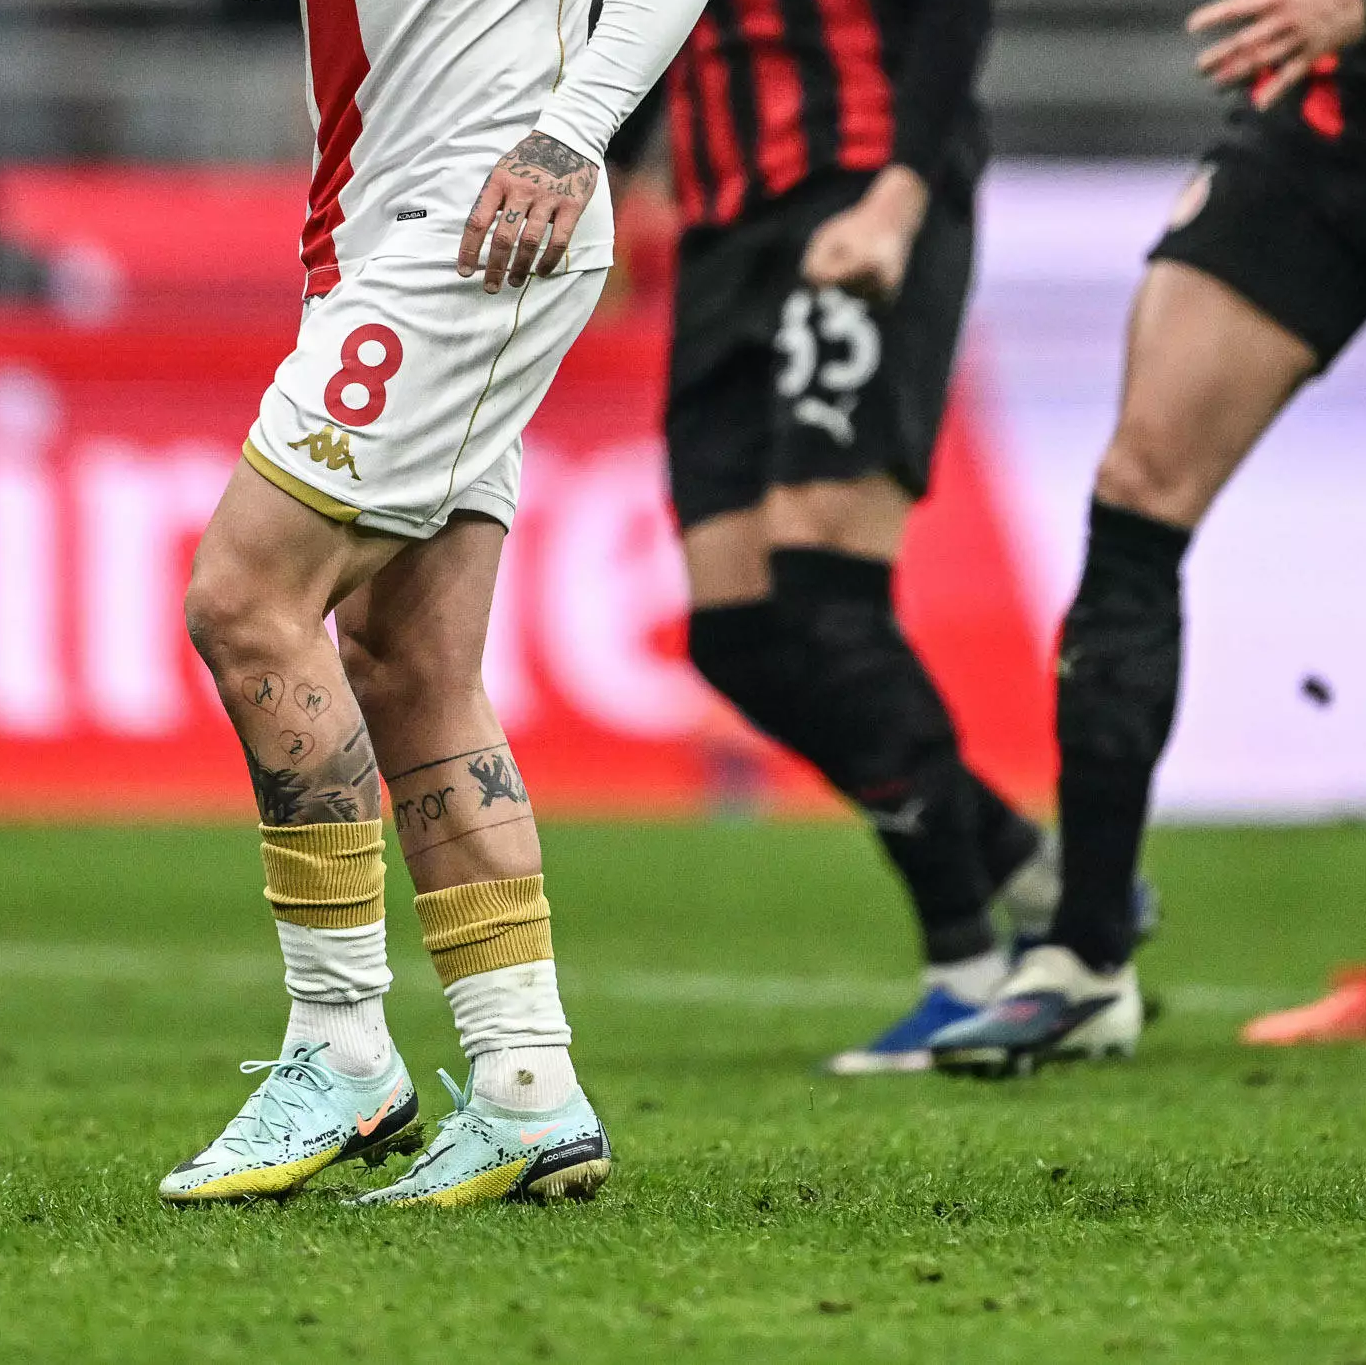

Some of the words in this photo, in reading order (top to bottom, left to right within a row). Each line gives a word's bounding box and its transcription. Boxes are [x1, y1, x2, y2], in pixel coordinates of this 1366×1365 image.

[324, 323, 403, 427] 8
[255, 677, 273, 705] A
[303, 1129, 338, 1147] PHANTOM
